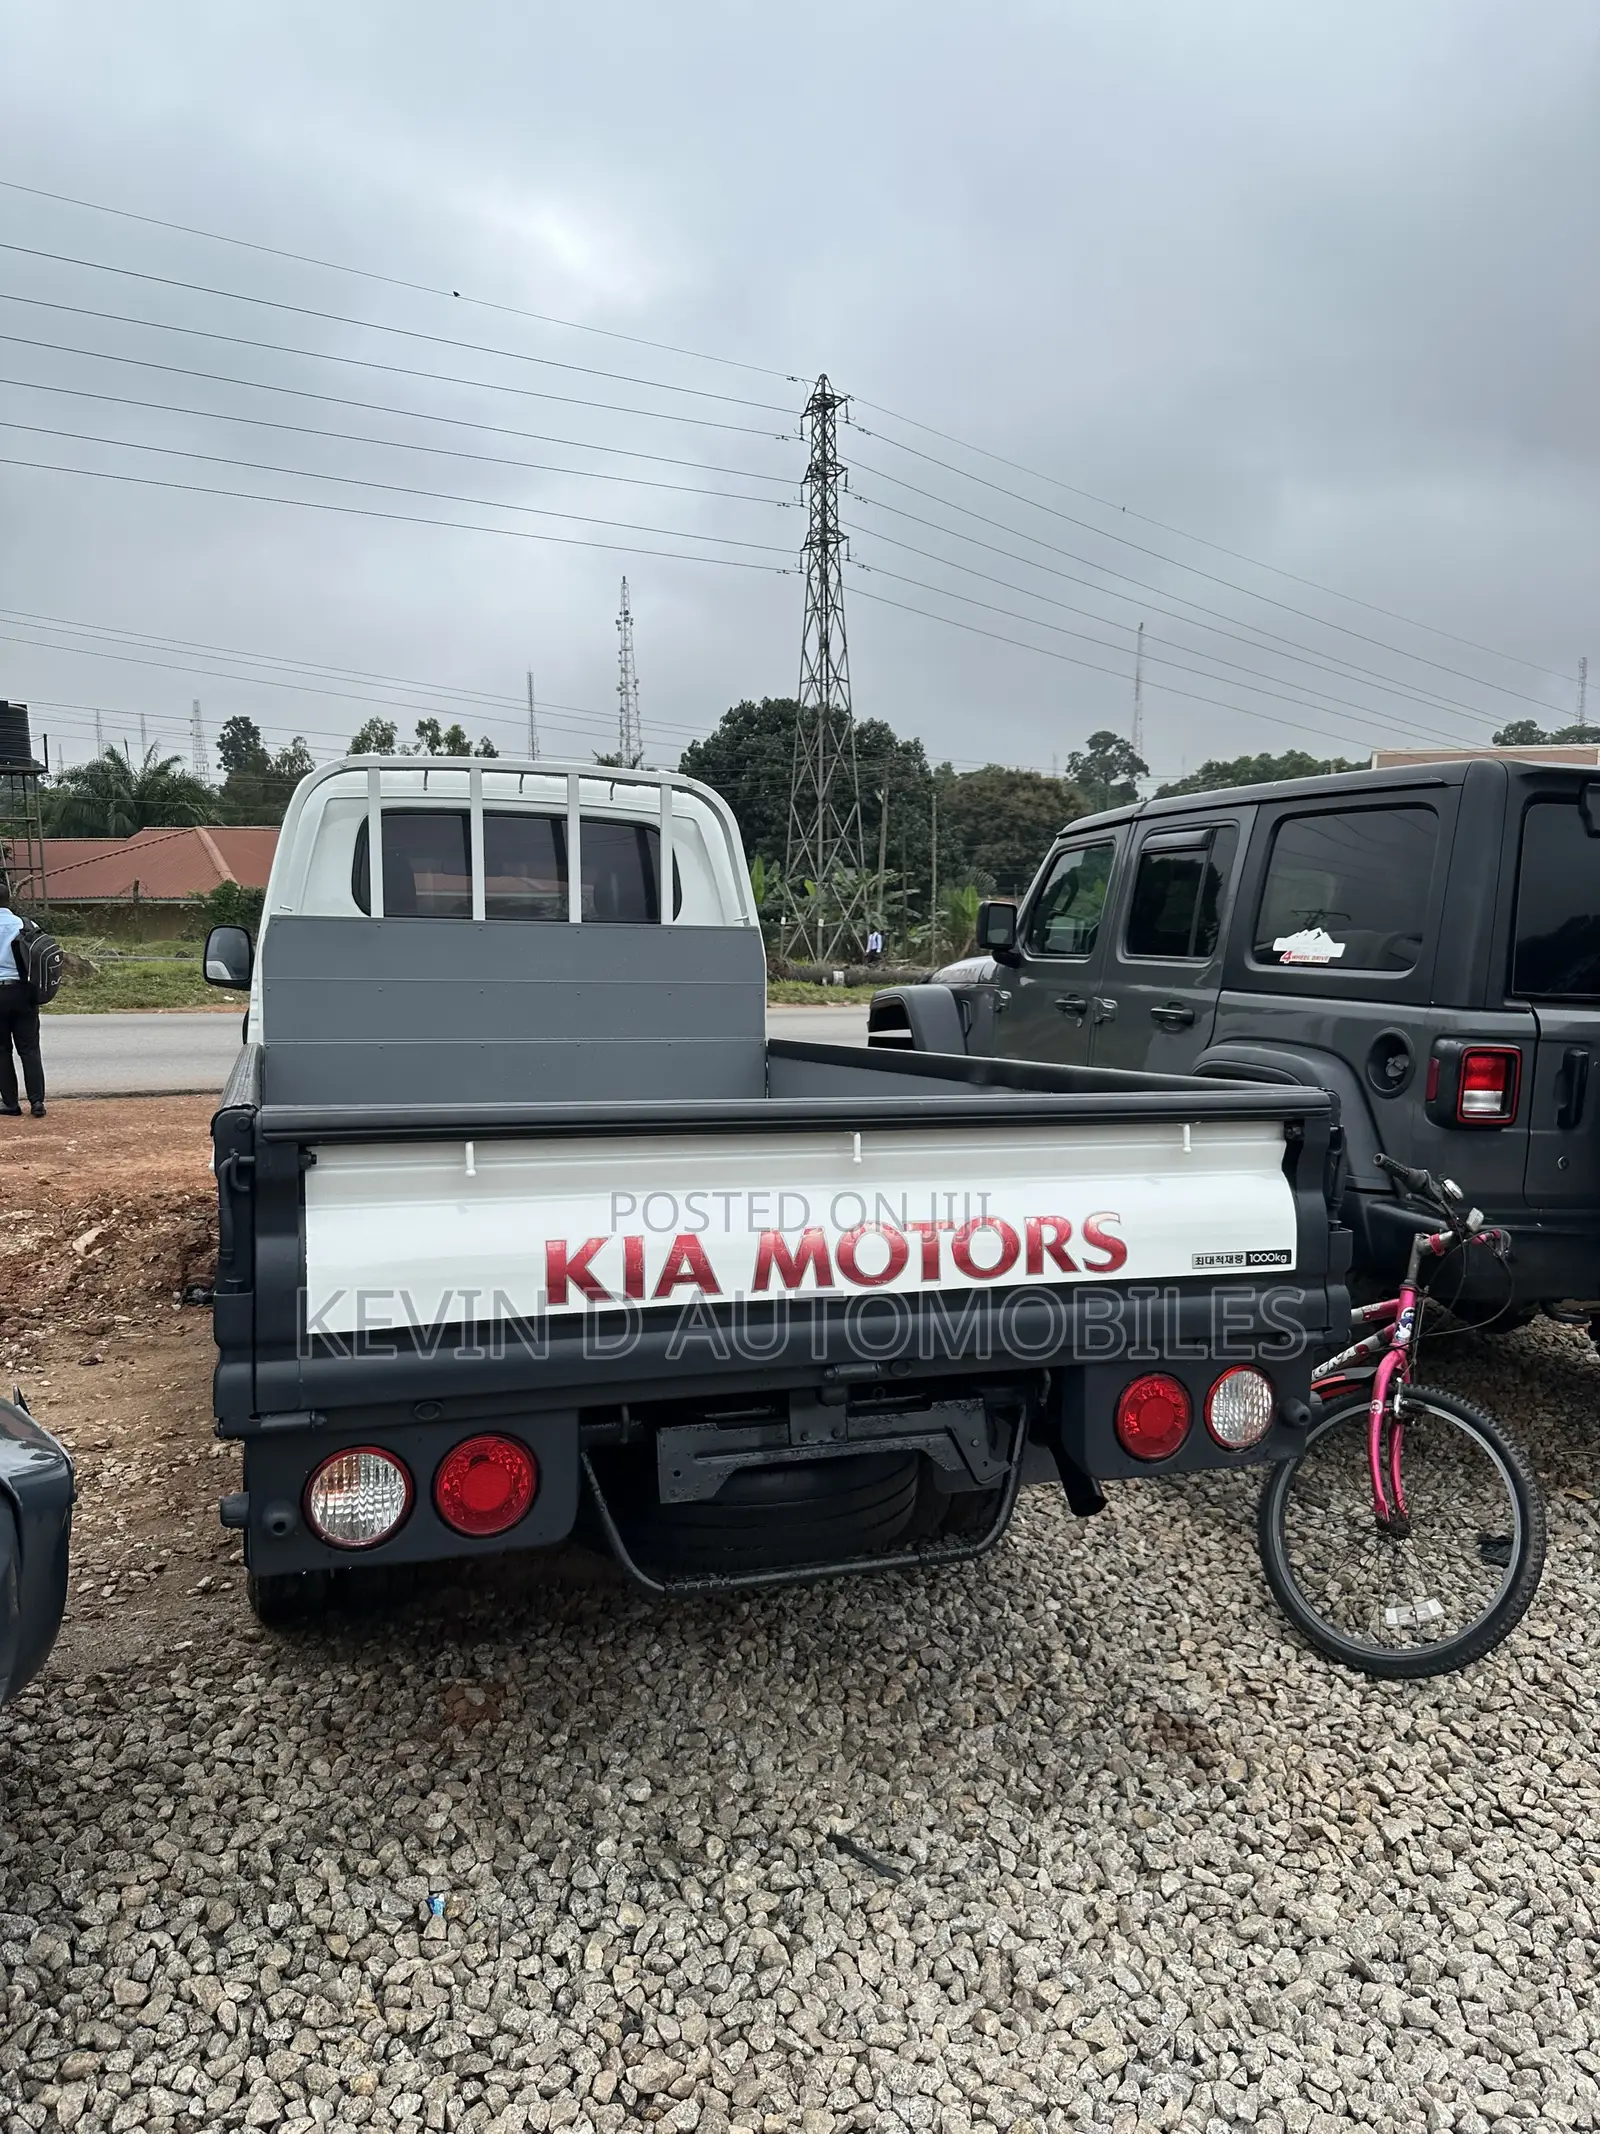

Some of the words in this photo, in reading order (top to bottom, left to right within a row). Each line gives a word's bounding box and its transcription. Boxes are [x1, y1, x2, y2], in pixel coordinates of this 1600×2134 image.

[1282, 951, 1292, 962] 4
[545, 1233, 724, 1307] KIA
[751, 1211, 1128, 1293] MOTORS
[1194, 1254, 1245, 1266] 최대적재량
[1249, 1252, 1288, 1264] 1000kg
